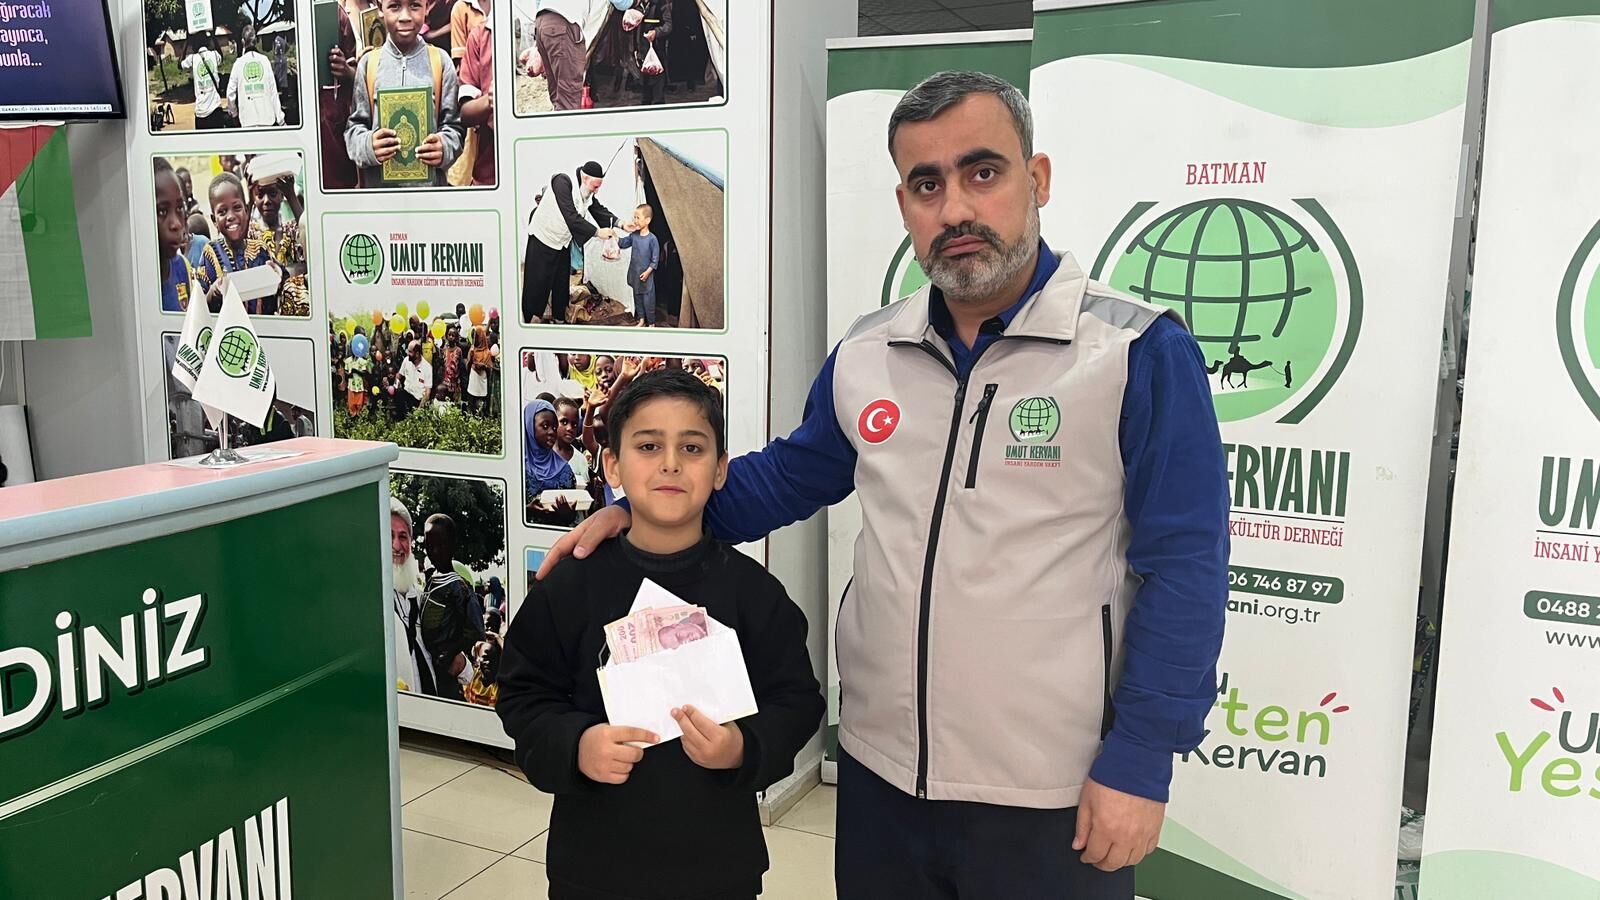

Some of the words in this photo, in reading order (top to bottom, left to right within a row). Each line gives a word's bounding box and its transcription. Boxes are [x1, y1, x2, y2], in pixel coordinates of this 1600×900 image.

[0, 48, 42, 66] unla...
[1185, 161, 1267, 185] BATMAN
[390, 243, 426, 272] UMUT
[431, 243, 483, 273] KERVANI
[178, 343, 200, 365] UMUT
[249, 366, 265, 389] UMUT
[1006, 445, 1028, 458] UMUT
[1030, 445, 1061, 459] KERVANI
[1229, 518, 1280, 541] KÜLTÜR
[1284, 526, 1343, 547] DERNEĞİ
[1534, 536, 1589, 562] İNSANİ
[1252, 574, 1281, 590] 746
[1286, 578, 1307, 593] 87
[1311, 581, 1333, 597] 97
[1227, 598, 1321, 624] ani.org.tr
[1536, 598, 1590, 618] 0488
[0, 587, 206, 734] DİNİZ
[1213, 687, 1330, 746] ten
[1558, 711, 1600, 754] U
